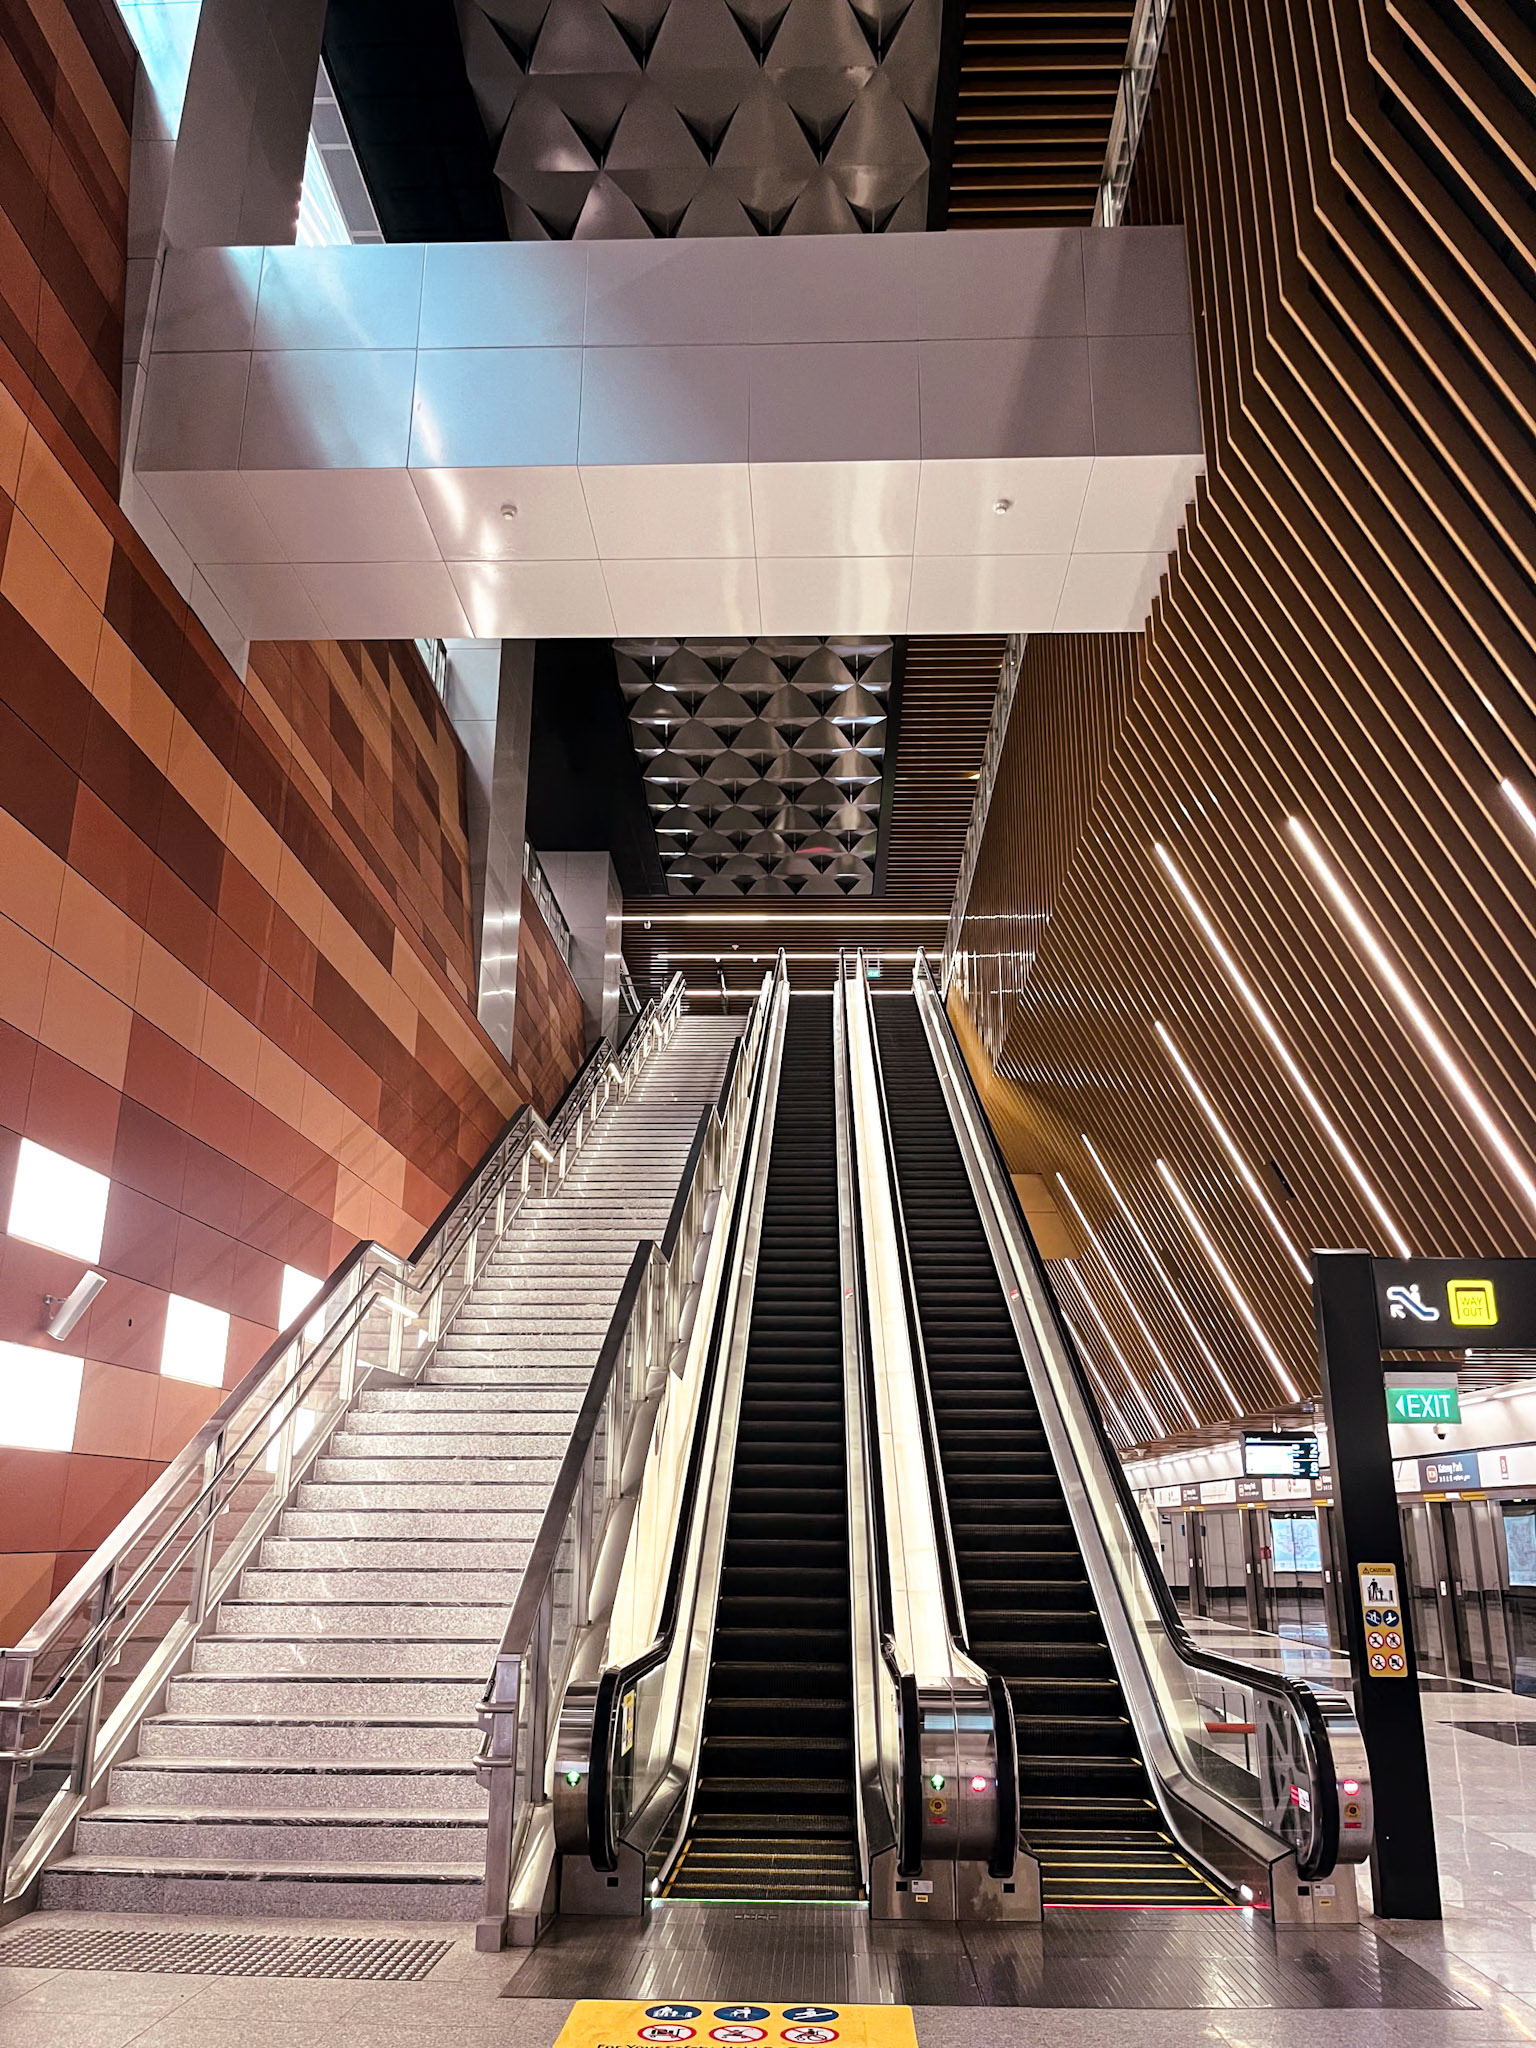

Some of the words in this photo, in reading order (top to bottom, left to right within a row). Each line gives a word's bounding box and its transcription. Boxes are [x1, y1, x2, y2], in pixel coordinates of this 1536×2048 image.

[1461, 1296, 1483, 1306] WAY
[1462, 1307, 1483, 1317] OUT
[1406, 1394, 1451, 1418] EXIT
[1309, 1443, 1318, 1454] 2
[1310, 1461, 1319, 1472] 8
